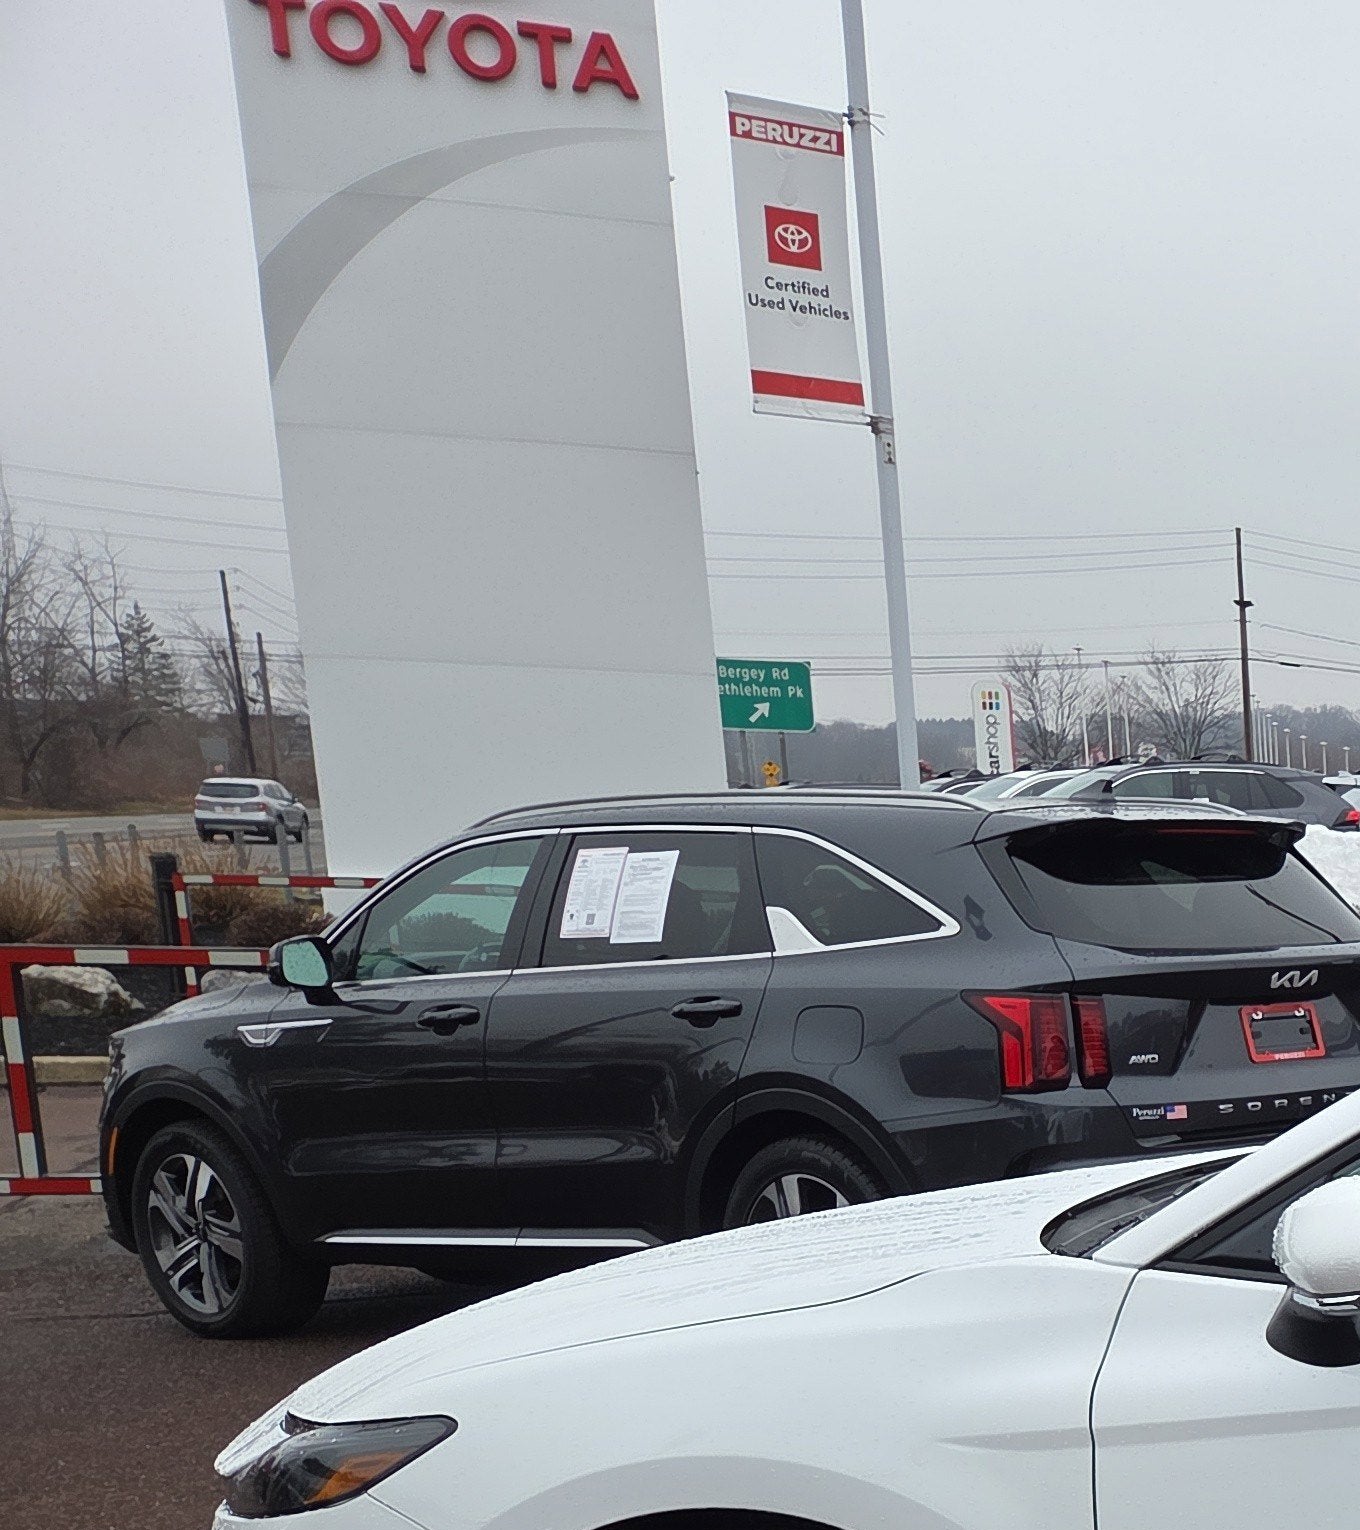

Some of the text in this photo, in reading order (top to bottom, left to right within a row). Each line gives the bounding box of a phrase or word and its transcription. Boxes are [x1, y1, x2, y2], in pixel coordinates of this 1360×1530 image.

[247, 0, 640, 100] TOYOTA
[734, 115, 838, 153] PERUZZI
[764, 276, 830, 299] Certified
[748, 292, 850, 320] Used Vehicles
[718, 665, 790, 682] Bergey Rd
[718, 682, 804, 698] ethlehem Pk
[1270, 969, 1319, 989] KIA
[1128, 1053, 1159, 1065] AWD
[1217, 1091, 1353, 1114] SOREN
